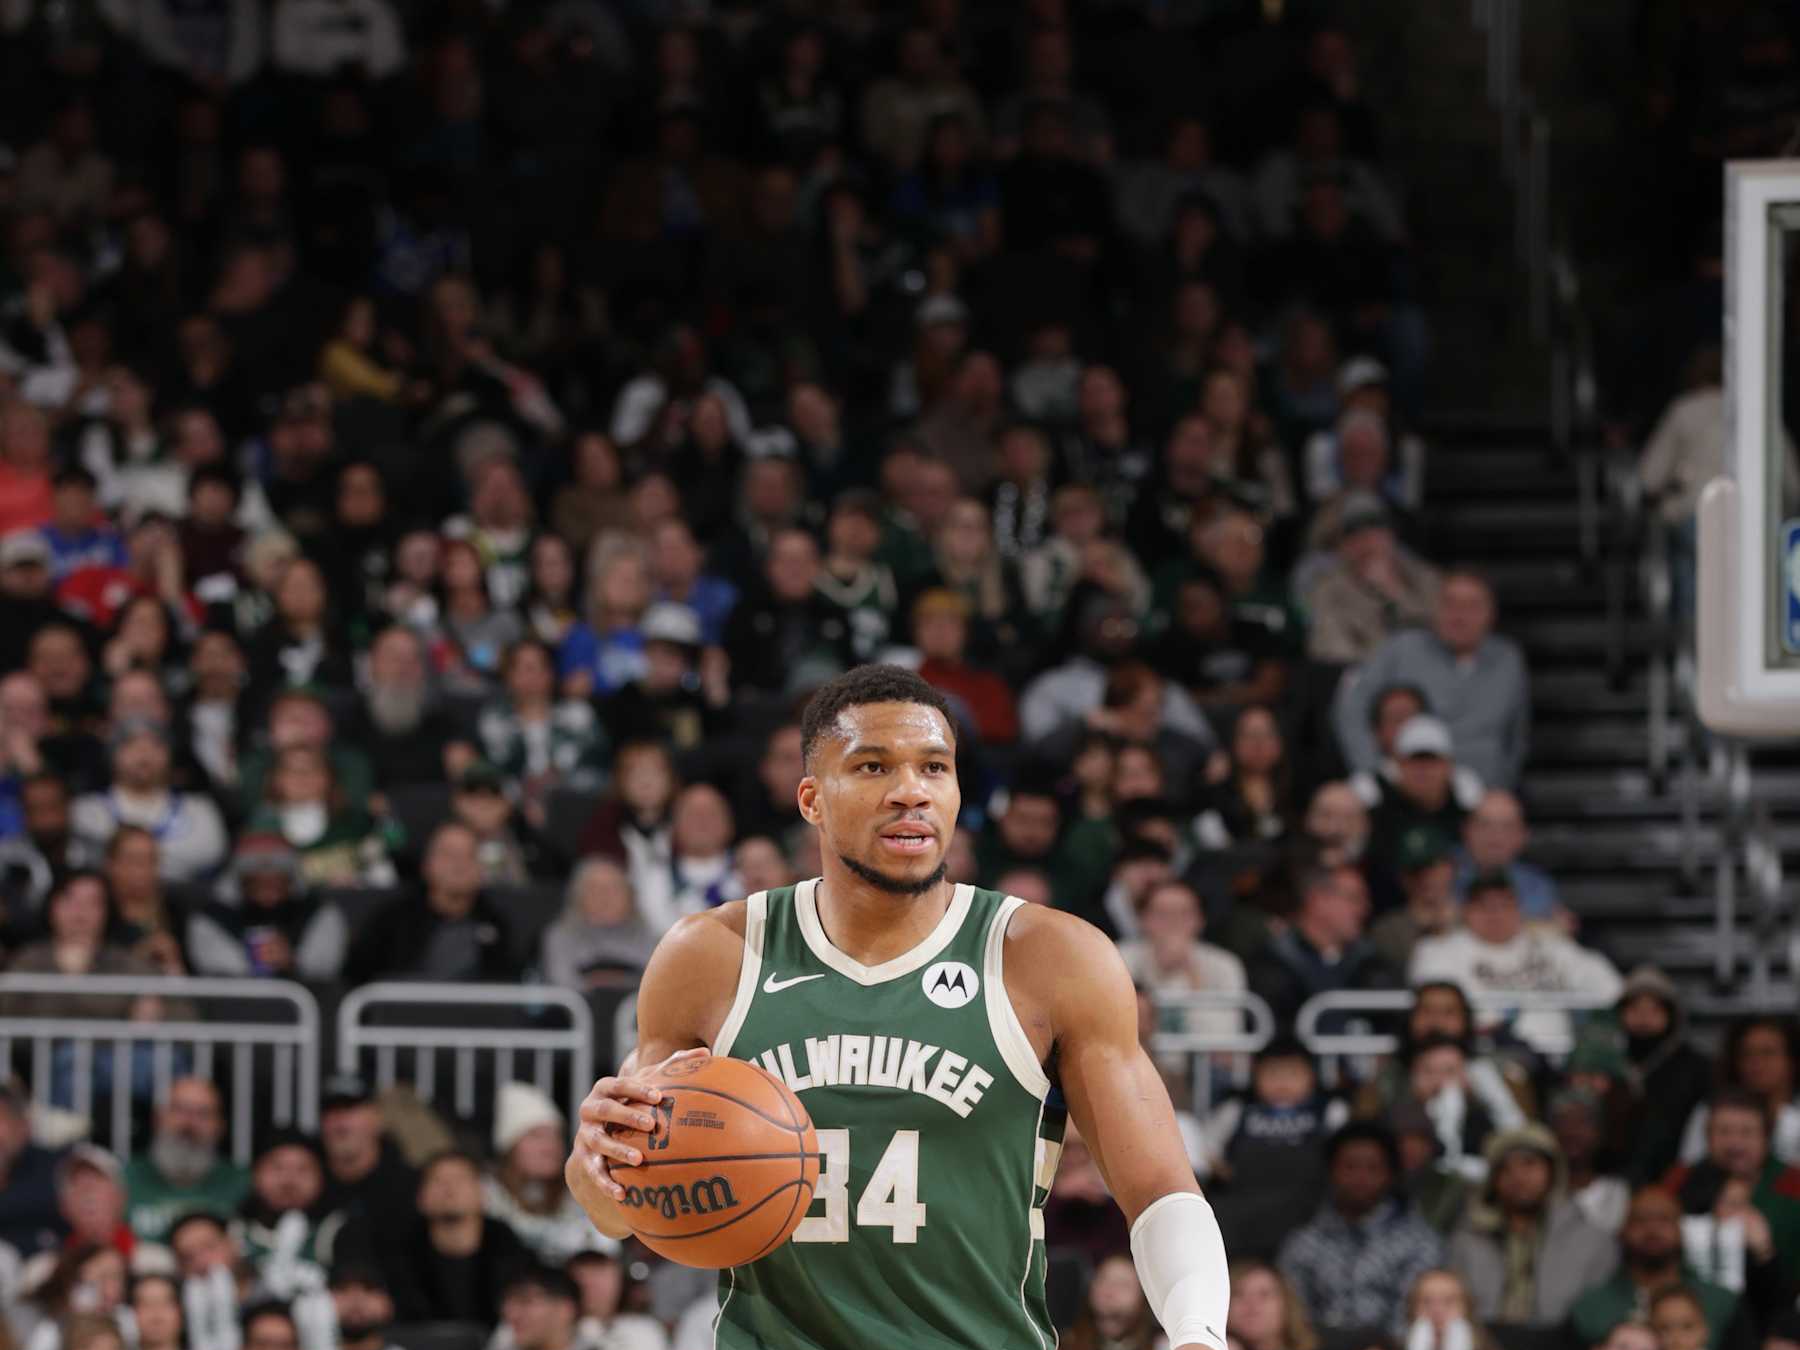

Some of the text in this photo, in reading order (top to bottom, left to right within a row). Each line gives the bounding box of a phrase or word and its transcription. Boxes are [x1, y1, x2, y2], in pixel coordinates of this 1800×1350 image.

[749, 1034, 995, 1119] ILWAUKEE
[618, 1175, 740, 1220] Wilso
[791, 1128, 927, 1243] 34
